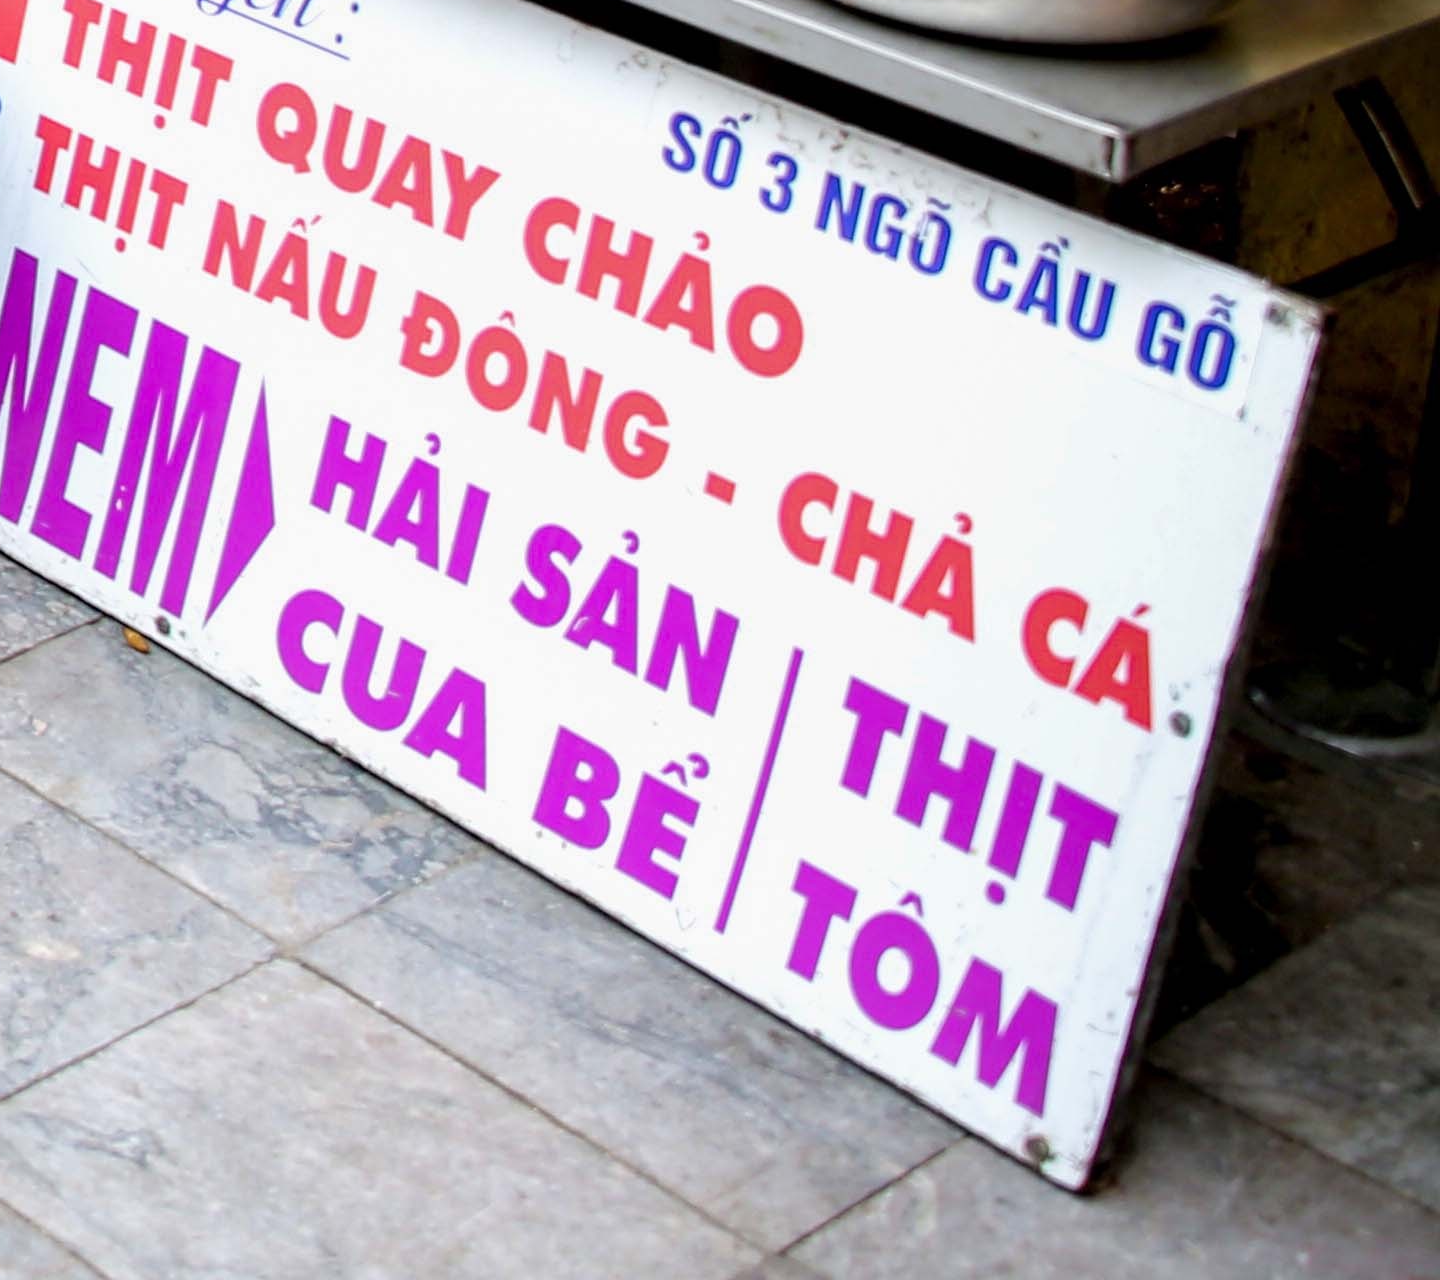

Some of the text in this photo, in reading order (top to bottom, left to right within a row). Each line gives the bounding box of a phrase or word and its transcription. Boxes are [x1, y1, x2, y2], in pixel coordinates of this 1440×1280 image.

[32, 113, 189, 254] THỊT
[201, 198, 378, 341] NẤU
[398, 289, 670, 480] ĐÔNG
[777, 470, 977, 644] CHẢ
[1019, 584, 1155, 735] CÁ
[256, 81, 502, 241] QUAY
[521, 195, 805, 379] CHẢO
[660, 109, 1238, 393] SỐ 3 NGÕ CẦU GỖ
[276, 587, 1058, 1120] CUA BỂ TÔM
[309, 412, 491, 588] HẢI
[508, 522, 741, 719] SẢN
[837, 675, 1120, 913] THỊT
